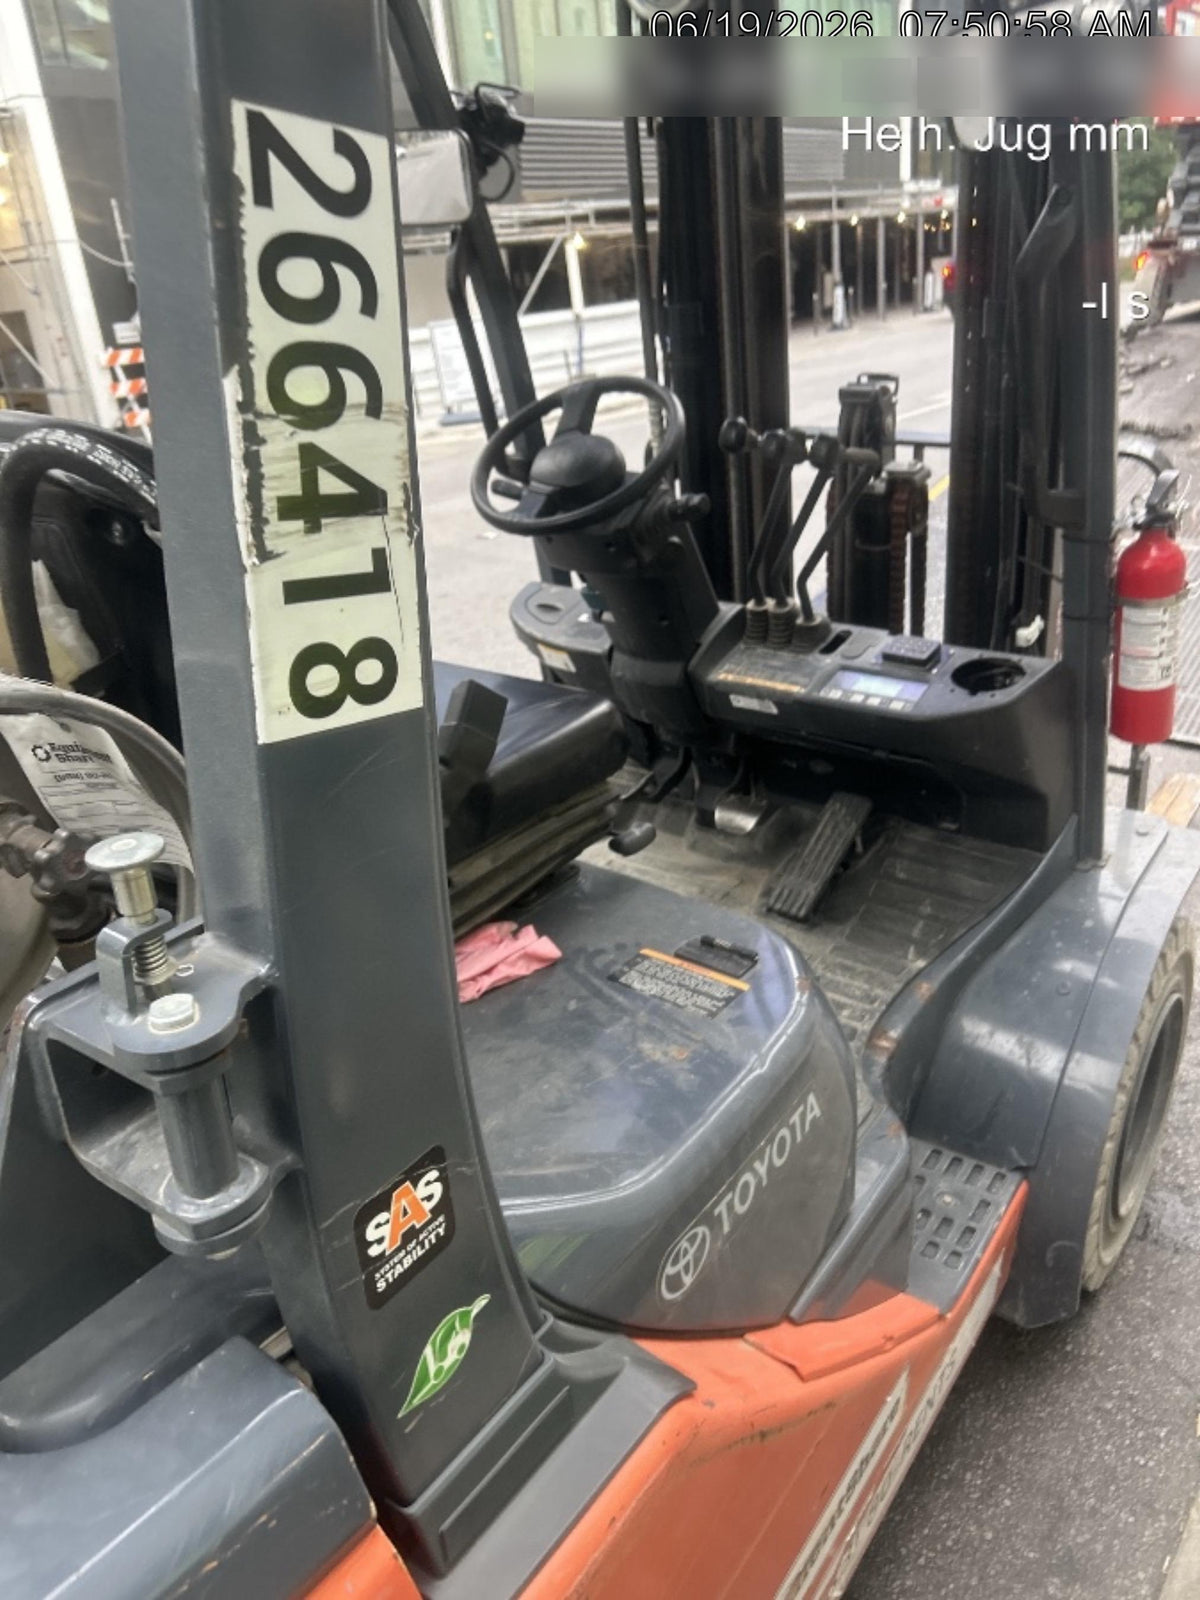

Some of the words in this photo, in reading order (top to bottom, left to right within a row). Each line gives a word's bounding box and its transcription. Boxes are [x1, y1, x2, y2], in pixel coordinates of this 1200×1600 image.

[245, 108, 399, 720] 266418
[714, 1091, 822, 1234] TOYOTA
[365, 1169, 443, 1258] SAS
[375, 1222, 447, 1293] STABILITY
[374, 1249, 406, 1281] SYSTEM
[406, 1238, 418, 1253] OF
